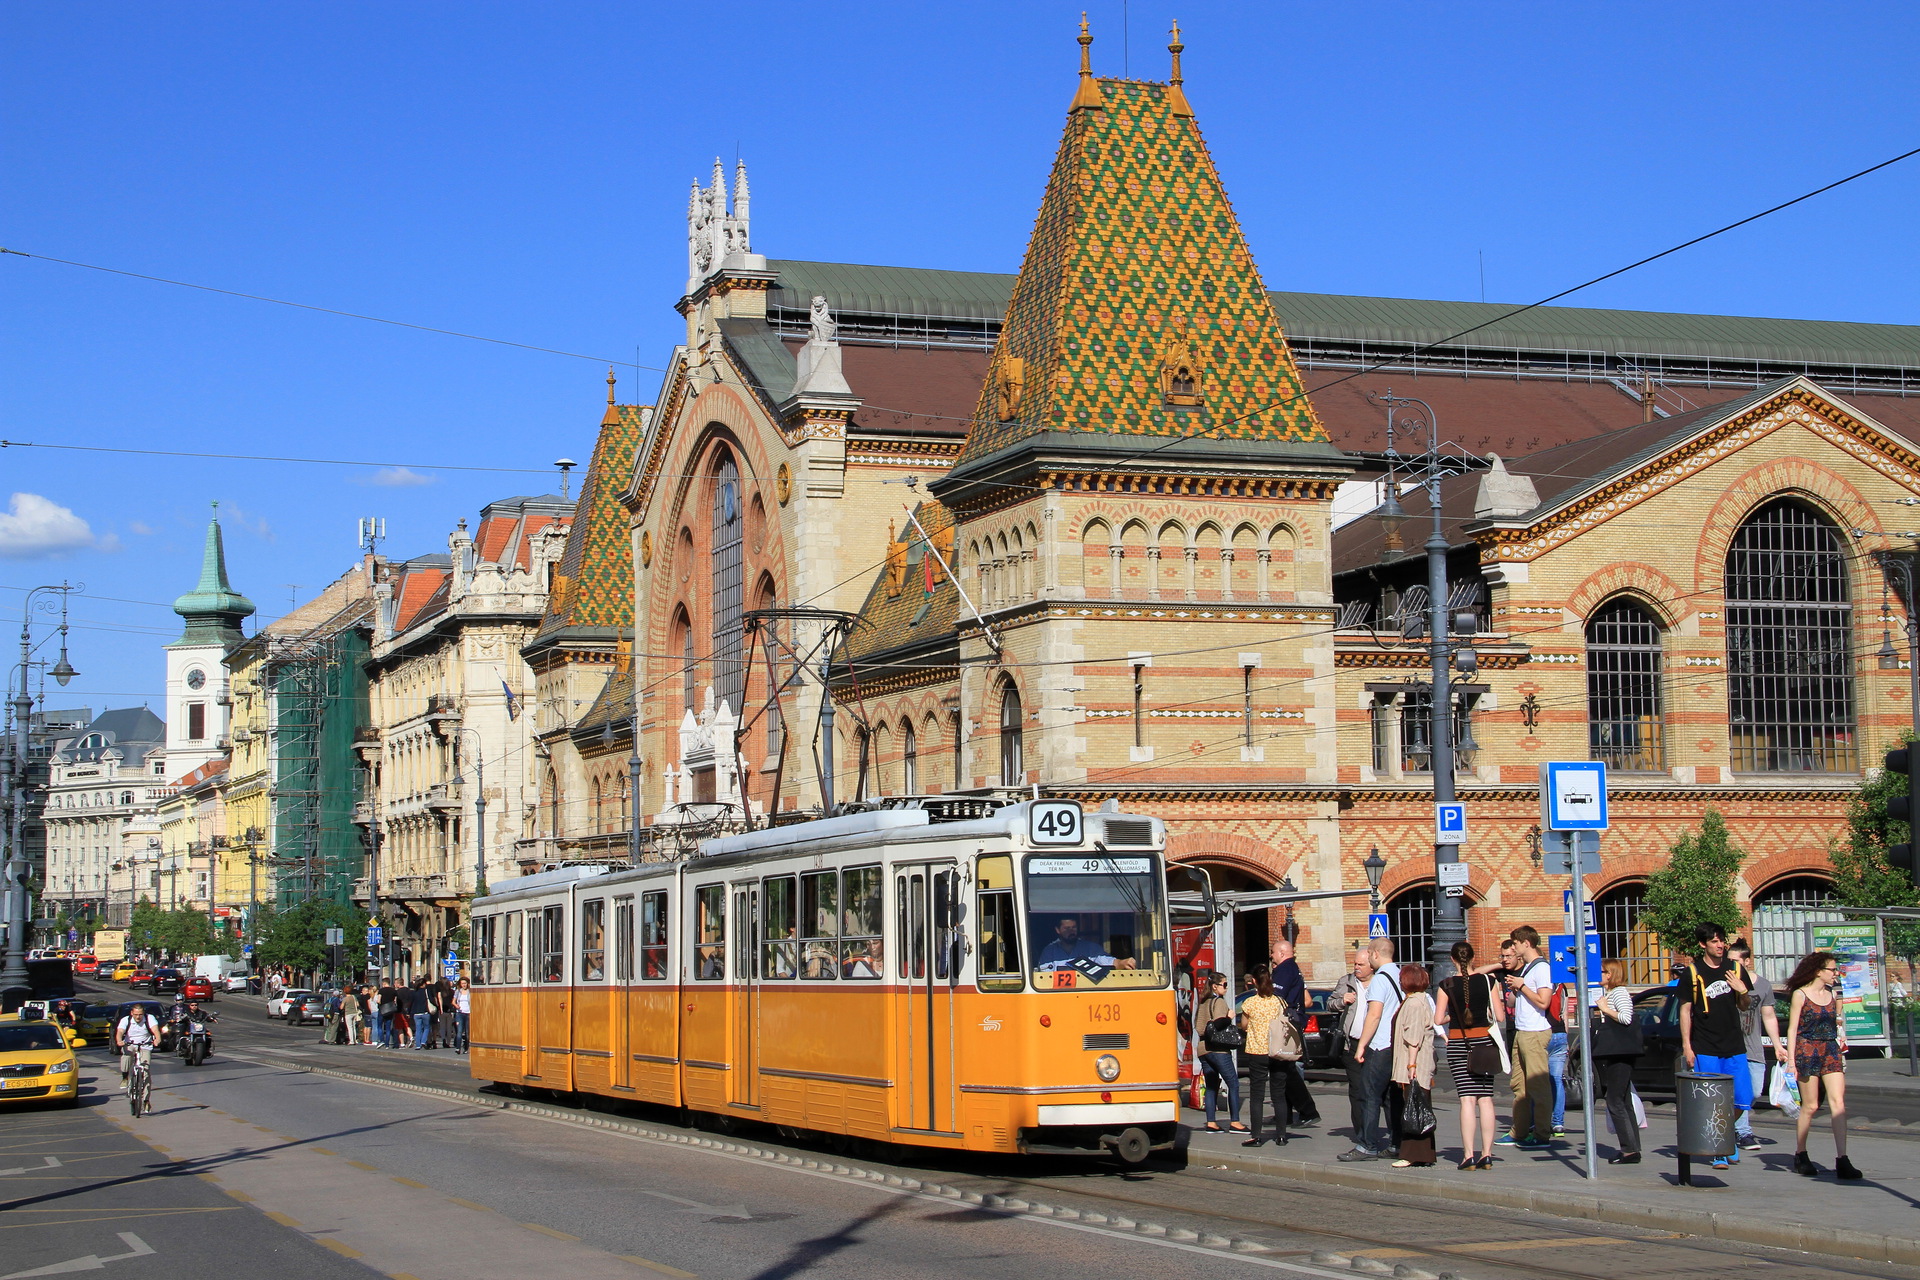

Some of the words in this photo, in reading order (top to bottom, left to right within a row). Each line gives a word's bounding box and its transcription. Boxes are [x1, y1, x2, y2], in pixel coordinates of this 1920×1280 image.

[1038, 810, 1075, 836] 49
[1444, 809, 1458, 828] P
[1082, 860, 1099, 872] 49
[1057, 973, 1072, 987] F2
[1088, 1004, 1121, 1022] 1438
[6, 1080, 36, 1088] ECS-201
[1691, 1082, 1723, 1102] Kiss
